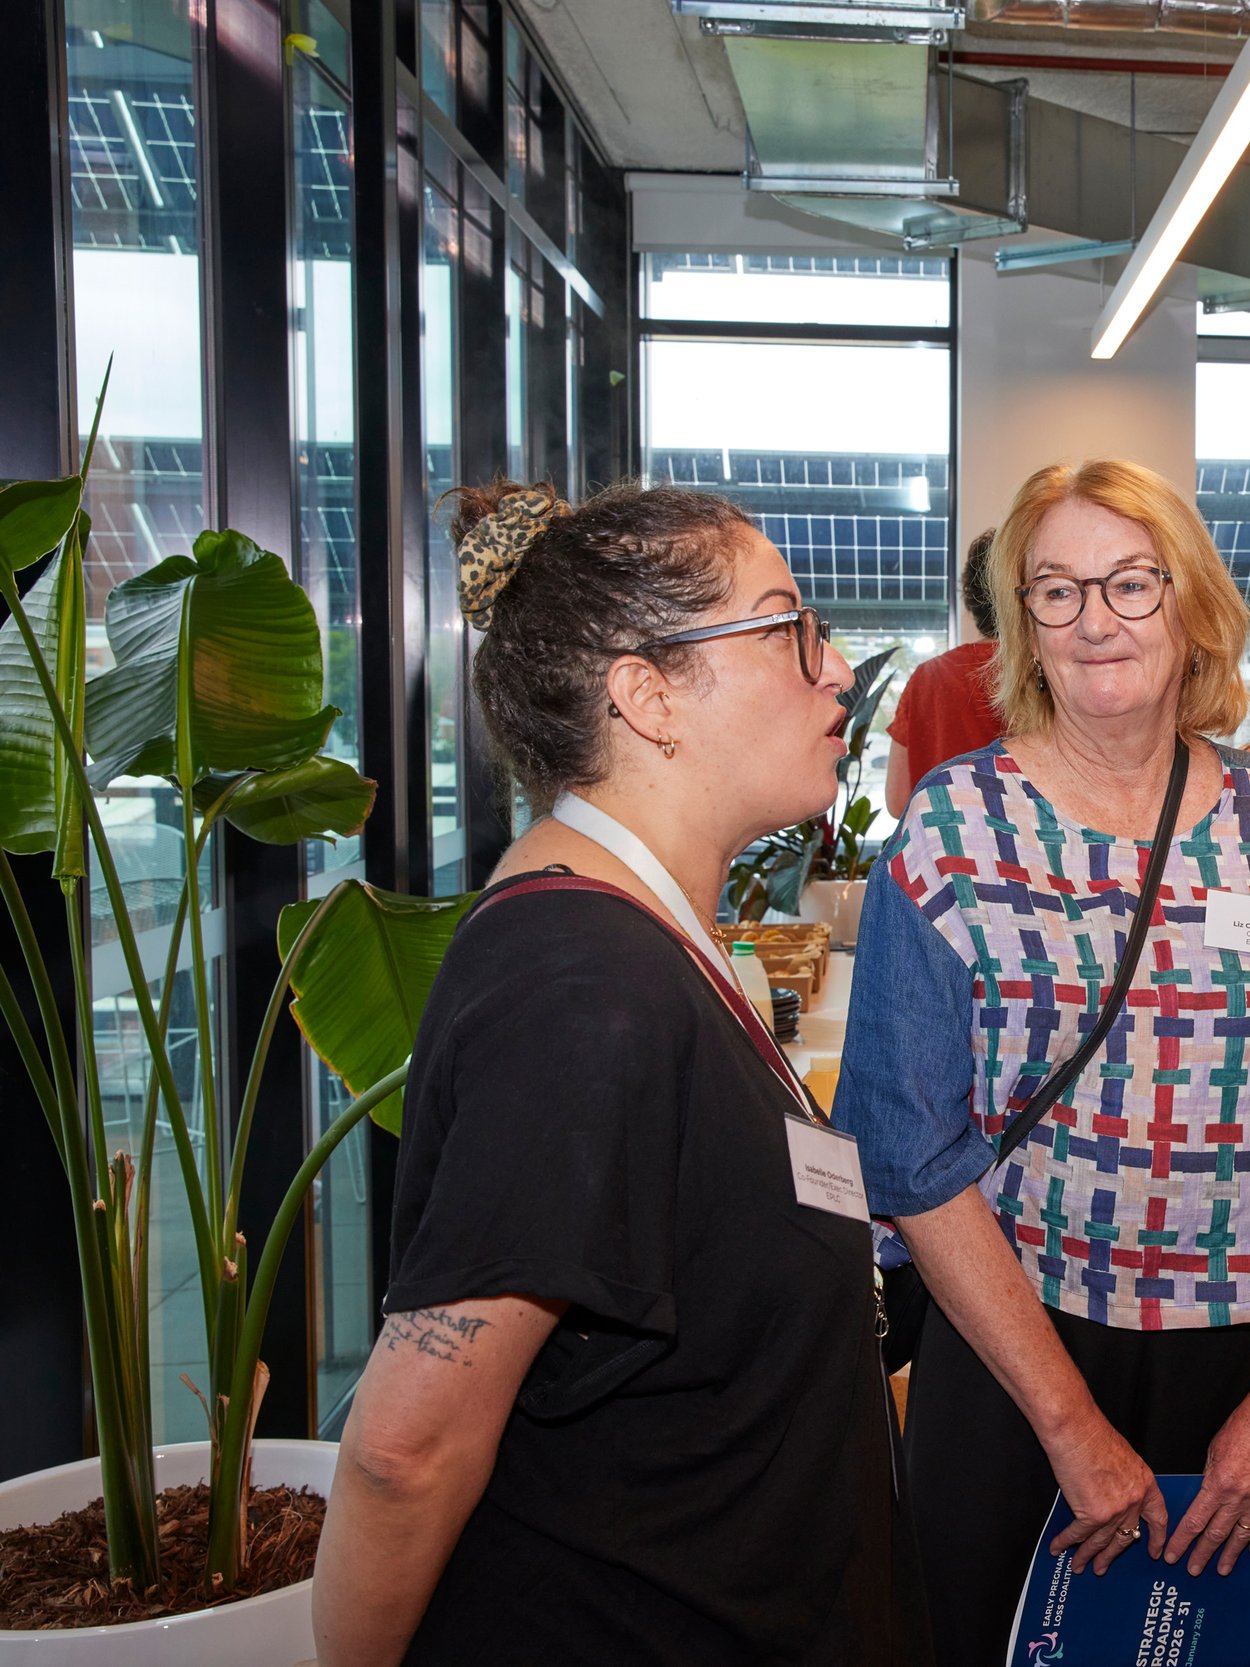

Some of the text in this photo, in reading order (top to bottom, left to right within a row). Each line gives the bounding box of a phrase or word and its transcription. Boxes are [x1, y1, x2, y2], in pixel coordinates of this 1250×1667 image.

[1043, 1549, 1068, 1627] EARLY PREGNANC
[1053, 1603, 1065, 1627] LOSS
[1136, 1581, 1165, 1667] STRATEGIC
[1150, 1586, 1178, 1667] ROADMAP
[1166, 1629, 1184, 1667] 2026
[1177, 1601, 1191, 1616] 31
[1184, 1607, 1205, 1667] January 2026
